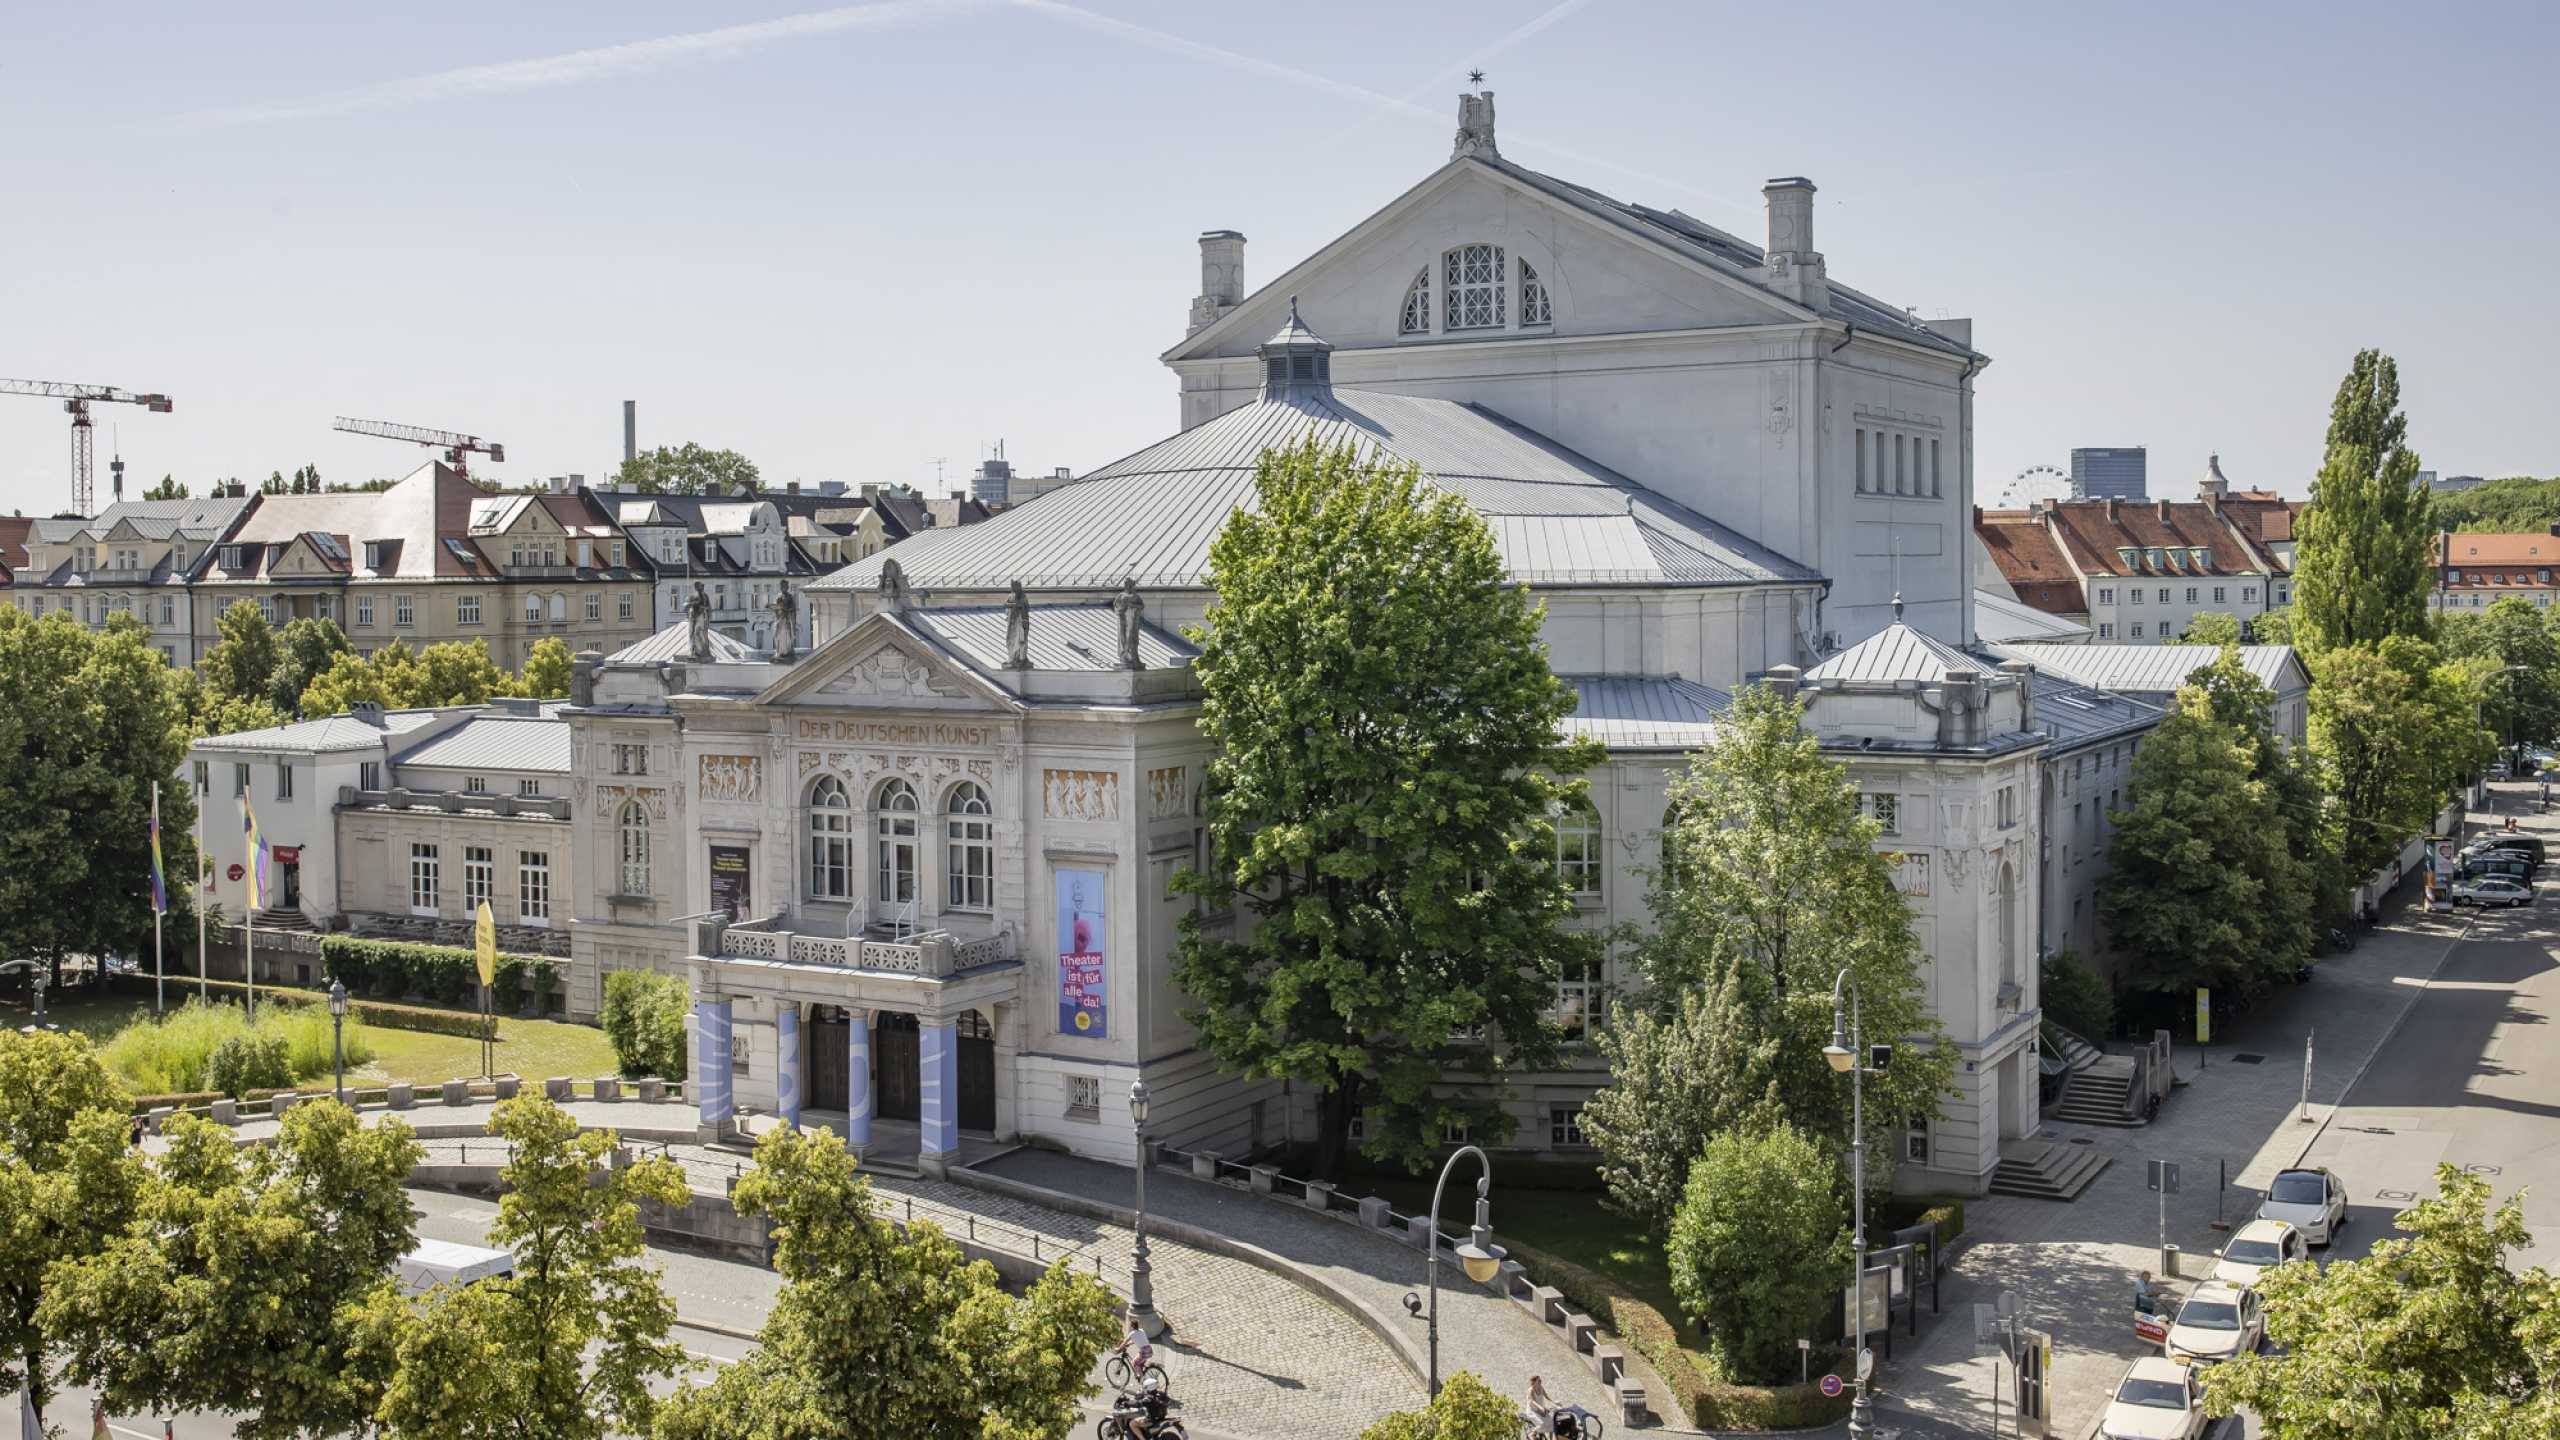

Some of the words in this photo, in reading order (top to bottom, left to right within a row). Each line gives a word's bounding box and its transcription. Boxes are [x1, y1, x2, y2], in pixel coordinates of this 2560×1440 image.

[800, 719, 831, 738] DER
[835, 720, 930, 743] DEUTSCHEN
[935, 724, 991, 745] KUNST
[1062, 955, 1101, 966] Theater
[1068, 970, 1082, 982] ist
[1085, 972, 1100, 983] für
[1064, 985, 1082, 996] alle
[1083, 996, 1100, 1008] da!
